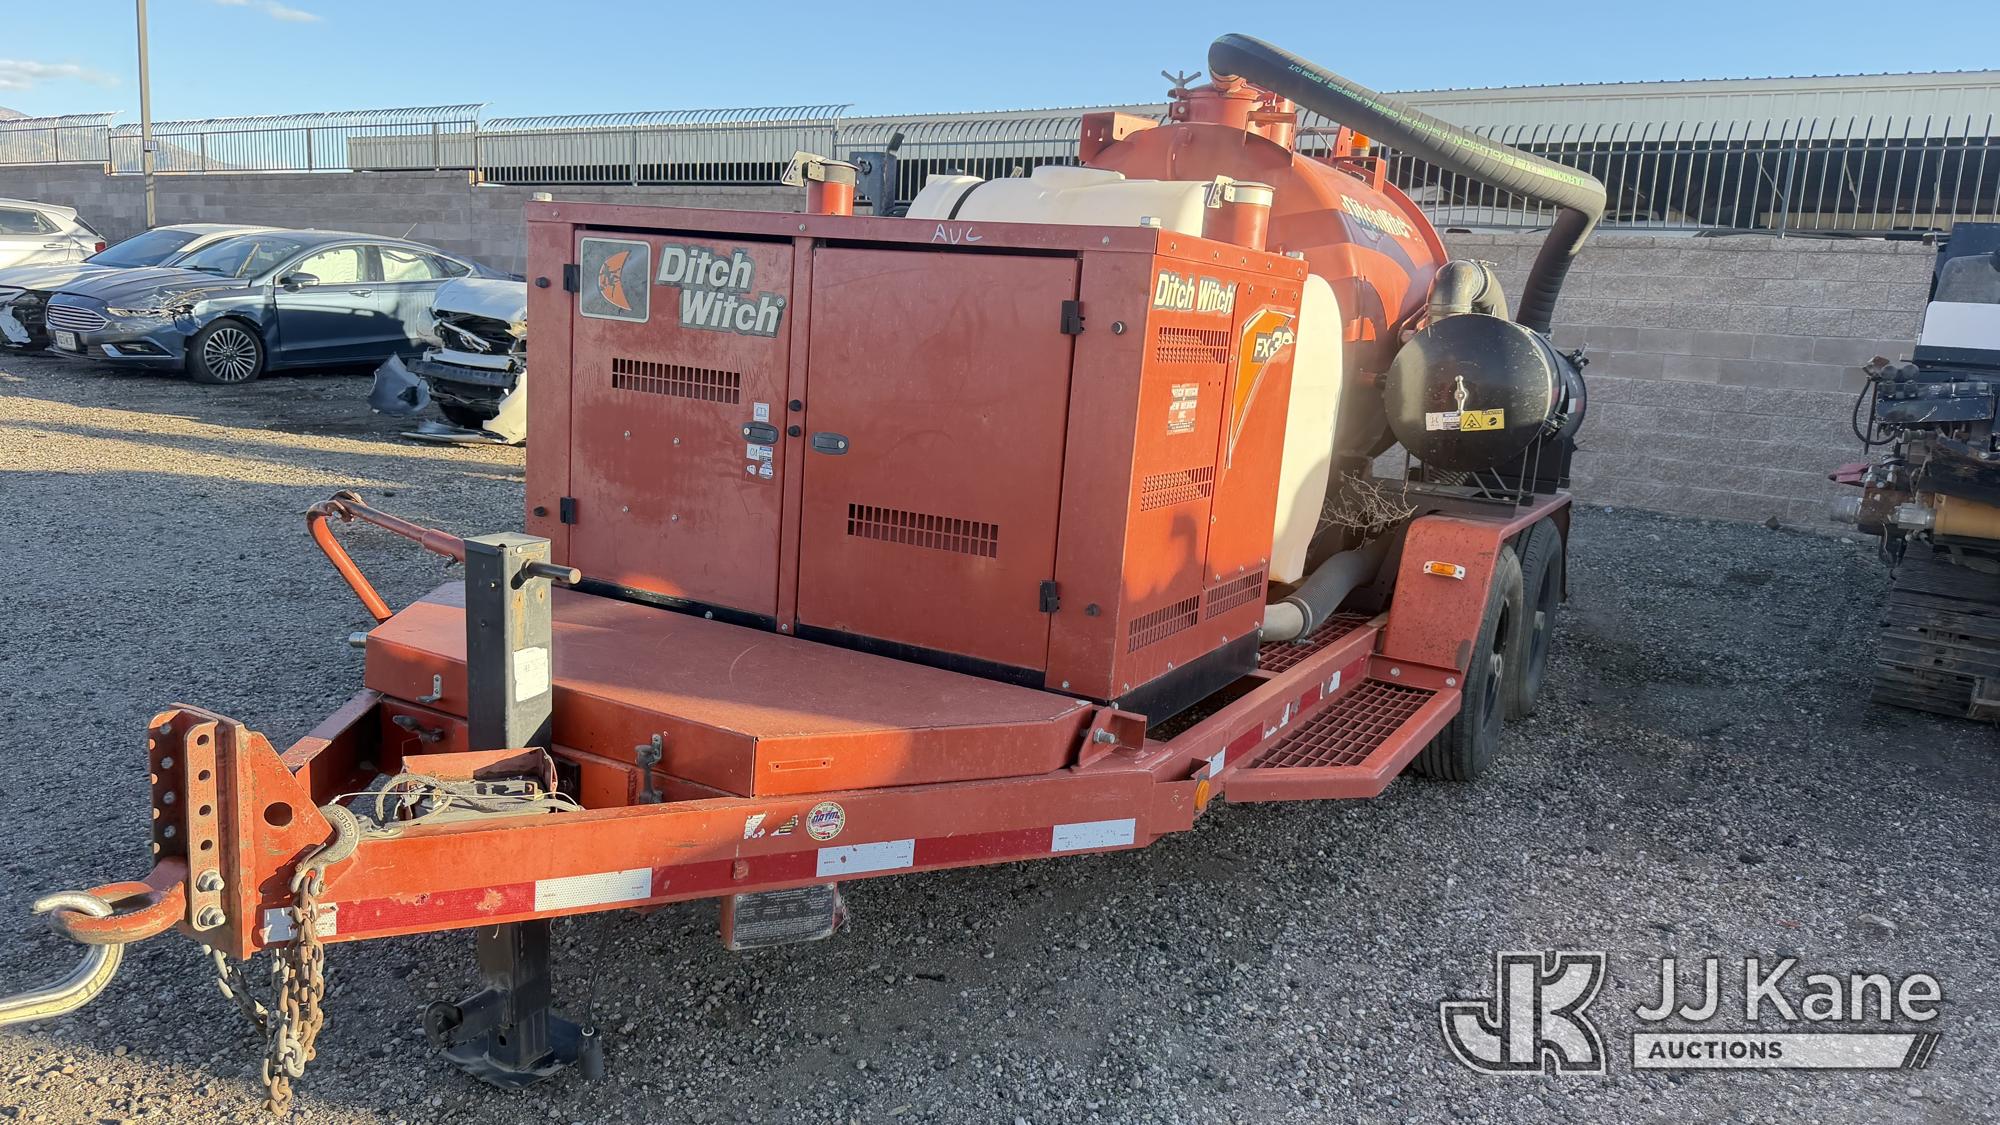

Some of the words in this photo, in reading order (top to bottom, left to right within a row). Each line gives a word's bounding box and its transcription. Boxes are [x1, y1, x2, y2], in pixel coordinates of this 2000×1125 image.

[1328, 83, 1362, 102] PURPOSE
[1364, 98, 1399, 118] GENERAL
[658, 247, 752, 289] Ditch
[682, 289, 779, 333] Witch
[1153, 273, 1196, 309] Ditch
[1197, 280, 1234, 314] Witch
